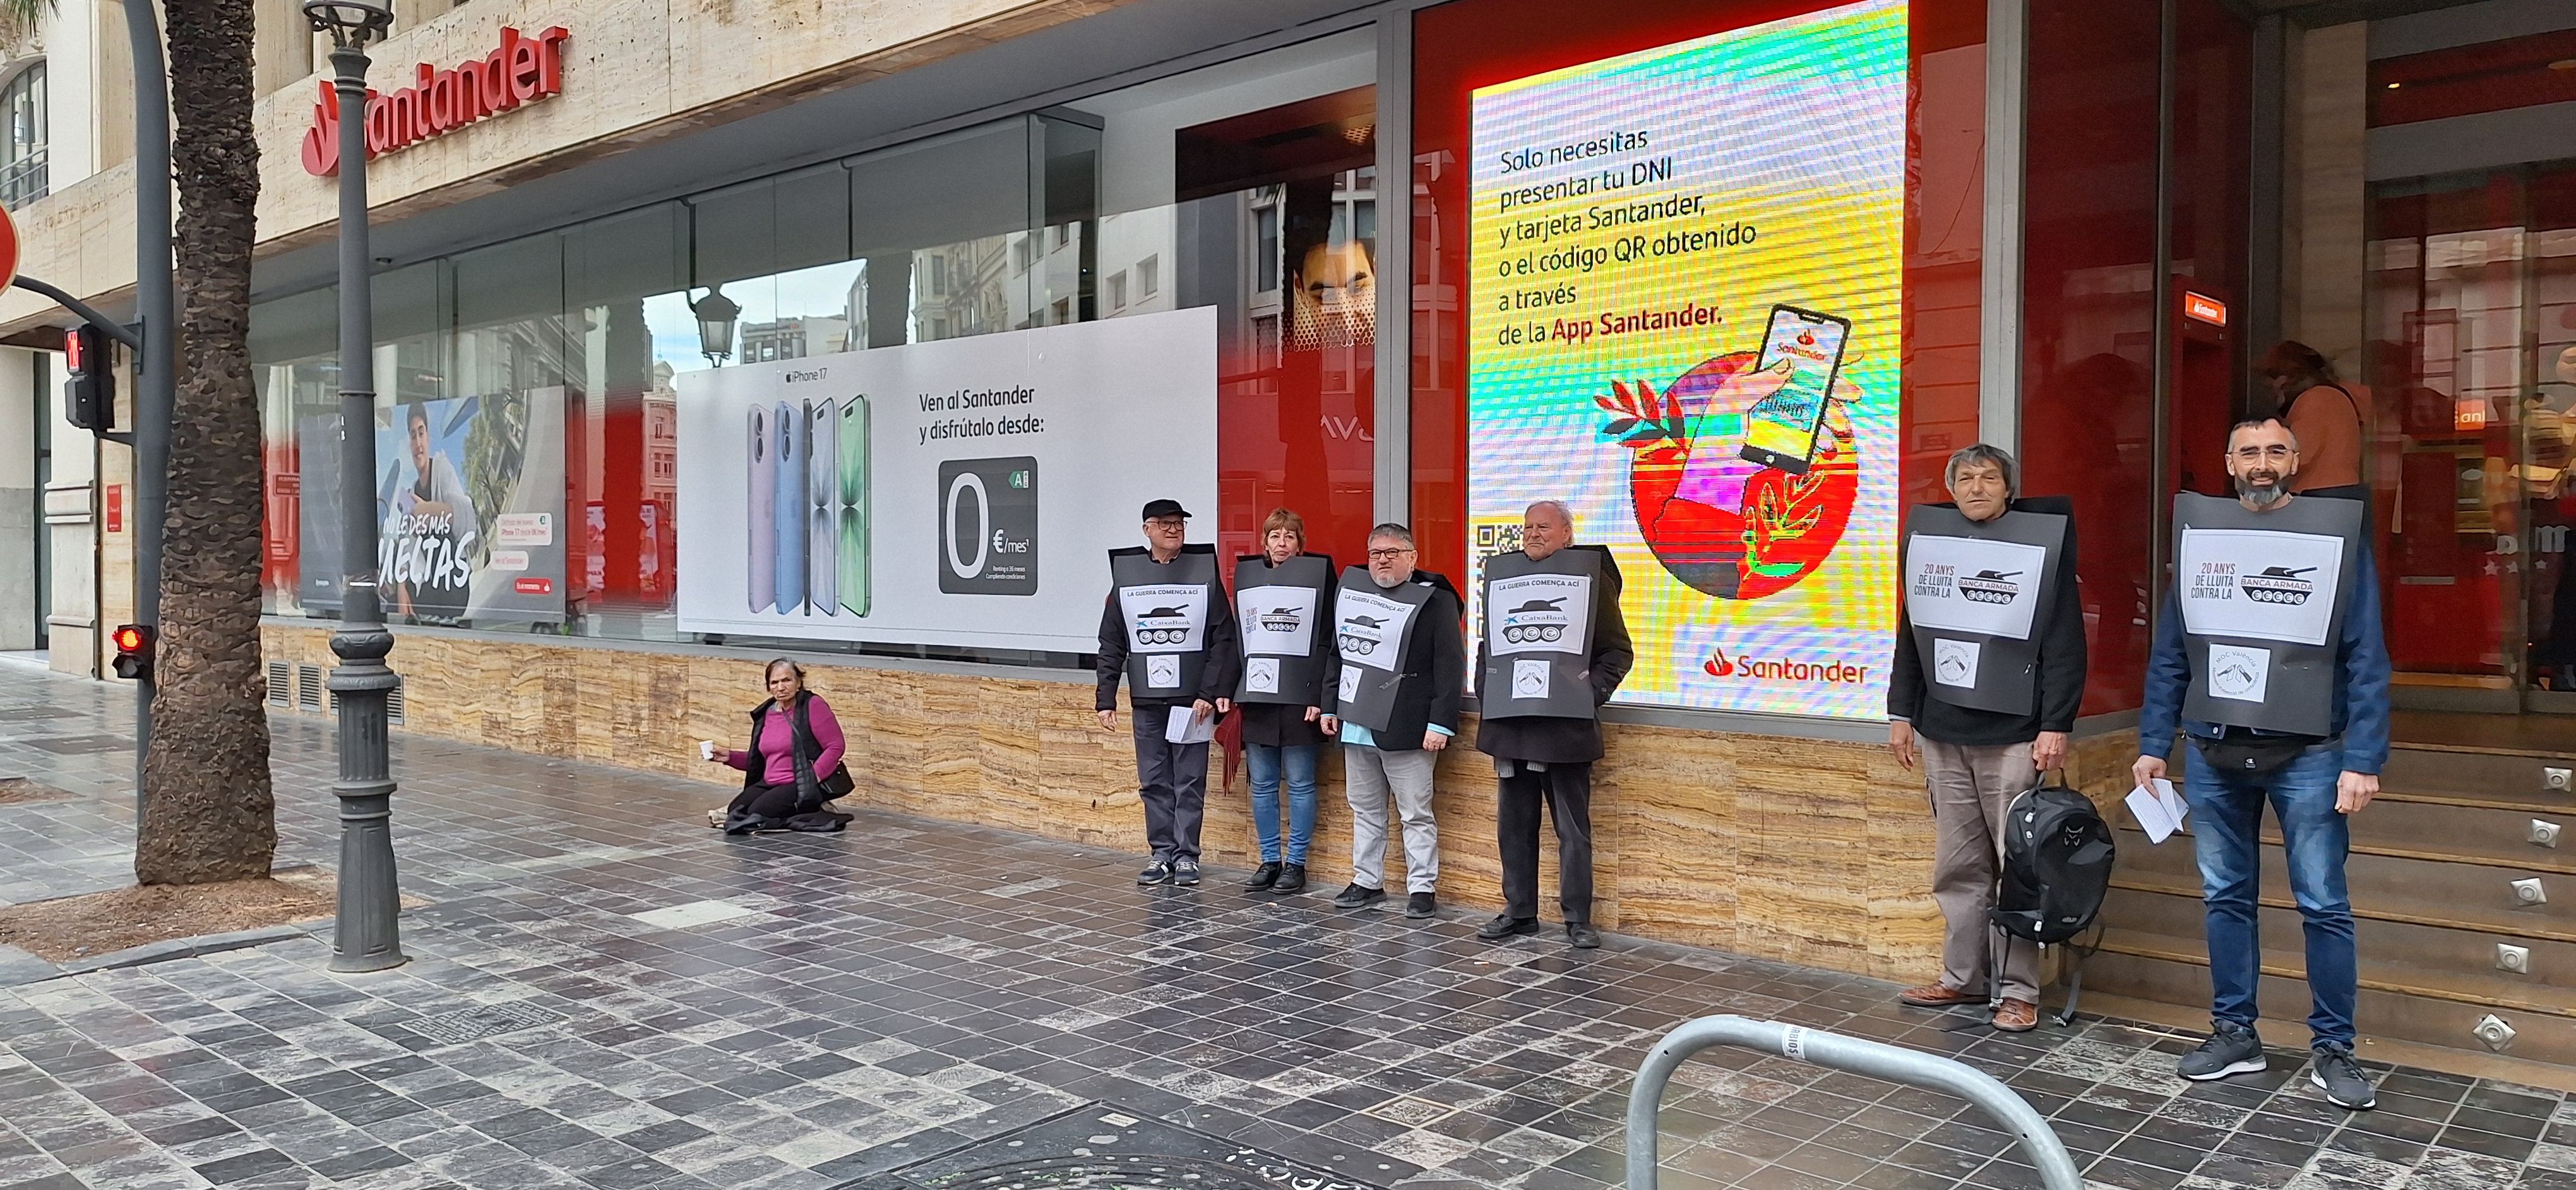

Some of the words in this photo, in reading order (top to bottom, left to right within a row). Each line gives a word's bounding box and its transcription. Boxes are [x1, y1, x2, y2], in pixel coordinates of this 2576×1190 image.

[1500, 150, 1543, 174] Solo
[1550, 129, 1648, 167] necesitas
[1501, 174, 1596, 213] presentar
[1603, 166, 1624, 189] tu
[1631, 156, 1673, 187] DNI
[1499, 225, 1512, 249] y
[1517, 214, 1582, 243] tarjeta
[1588, 192, 1705, 231] Santander,
[1498, 261, 1511, 277] o
[1517, 255, 1534, 275] el
[1539, 246, 1607, 272] código
[1614, 237, 1646, 262] QR
[1652, 221, 1757, 258] obtenido
[1498, 294, 1510, 311] a
[1516, 284, 1577, 310] través
[1498, 324, 1522, 346] de
[1528, 320, 1546, 344] la
[1551, 318, 1594, 344] App
[1599, 303, 1723, 335] Santander.
[792, 370, 818, 383] iPhone
[819, 367, 828, 380] 17
[919, 393, 944, 412] Ven
[947, 390, 959, 410] al
[962, 384, 1035, 409] Santander
[919, 426, 927, 446] y
[930, 417, 994, 440] disfrútalo
[998, 413, 1044, 435] desde:
[383, 517, 395, 534] NO
[397, 514, 408, 535] LE
[408, 514, 429, 536] DES
[429, 510, 452, 535] MÁS
[946, 472, 989, 579] 0
[378, 531, 475, 592] UELTAS
[1924, 563, 1933, 574] 20
[1935, 565, 1955, 575] ANYS
[2202, 562, 2211, 574] 20
[2214, 563, 2236, 574] ANYS
[1508, 581, 1530, 589] GUERRA
[1919, 575, 1926, 585] DE
[1929, 575, 1952, 587] LLUITA
[1958, 579, 1983, 588] BANCA
[1985, 582, 2019, 592] ARMADA
[2196, 575, 2204, 586] DE
[2207, 575, 2233, 587] LLUITA
[2241, 579, 2270, 587] BANCA
[2274, 581, 2313, 591] ARMADA
[1914, 586, 1940, 598] CONTRA
[1941, 588, 1950, 598] LA
[2191, 587, 2219, 599] CONTRA
[2222, 589, 2232, 599] LA
[1370, 600, 1396, 611] COMENÇA
[1351, 627, 1382, 639] CaixaBank
[1938, 644, 1948, 654] MOC
[2215, 651, 2231, 664] MOC
[2232, 651, 2257, 668] València
[1738, 655, 1869, 684] Santander
